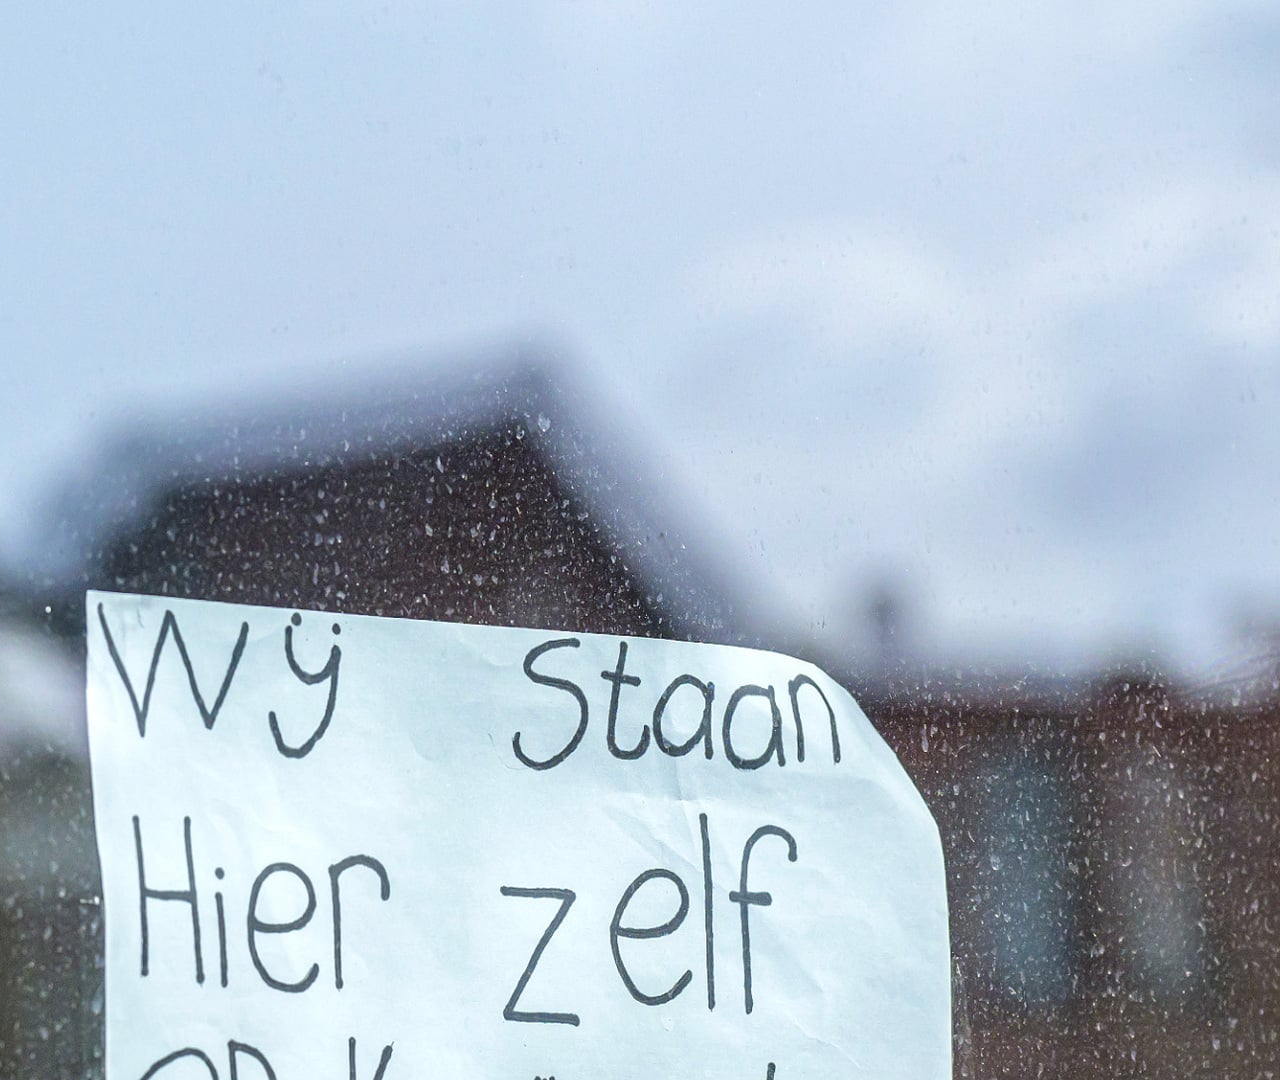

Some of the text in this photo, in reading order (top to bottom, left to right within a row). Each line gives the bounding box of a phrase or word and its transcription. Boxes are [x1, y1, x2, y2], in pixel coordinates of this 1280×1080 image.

[512, 637, 842, 770] Staan
[132, 813, 798, 1027] Hier zelf
